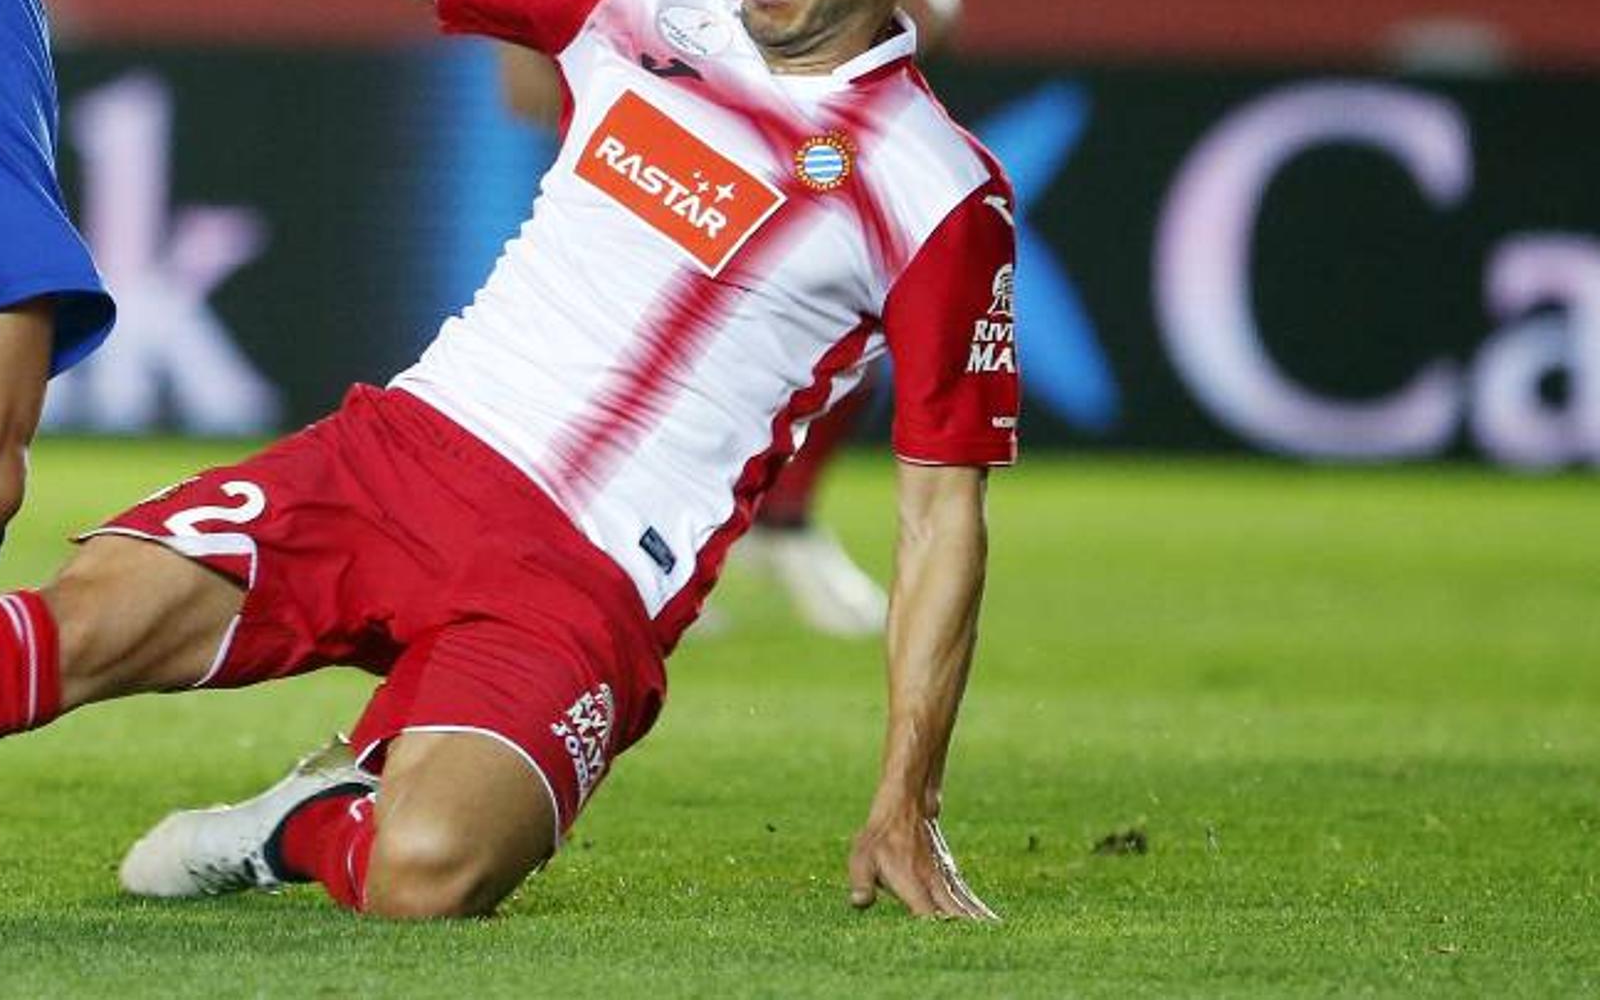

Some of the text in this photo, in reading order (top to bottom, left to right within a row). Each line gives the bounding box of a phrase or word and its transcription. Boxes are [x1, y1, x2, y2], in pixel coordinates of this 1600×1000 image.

[594, 135, 728, 239] RASTAR
[964, 342, 1017, 374] MA
[161, 479, 267, 557] 2
